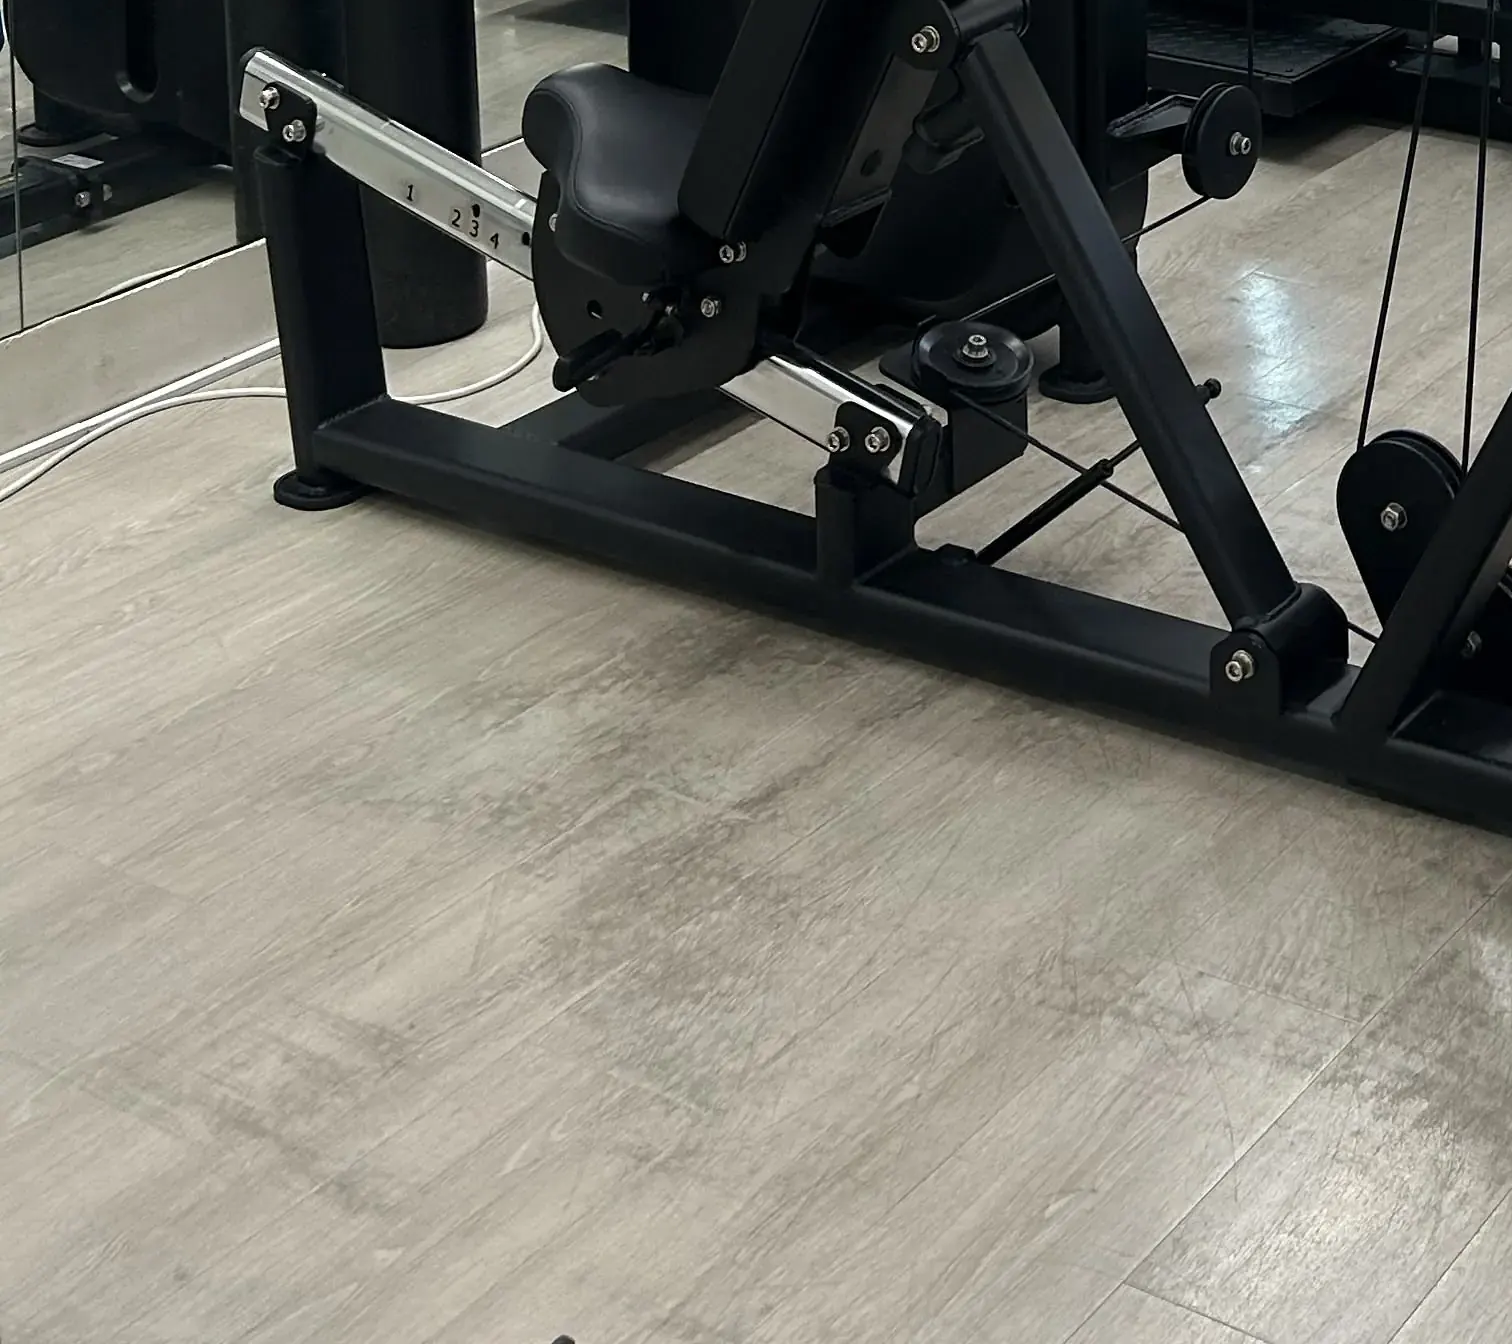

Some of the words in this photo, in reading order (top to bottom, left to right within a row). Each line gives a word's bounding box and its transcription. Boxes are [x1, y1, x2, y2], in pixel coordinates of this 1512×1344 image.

[406, 184, 414, 201] 1
[451, 208, 461, 227] 2
[469, 219, 479, 238] 3
[489, 232, 499, 249] 4
